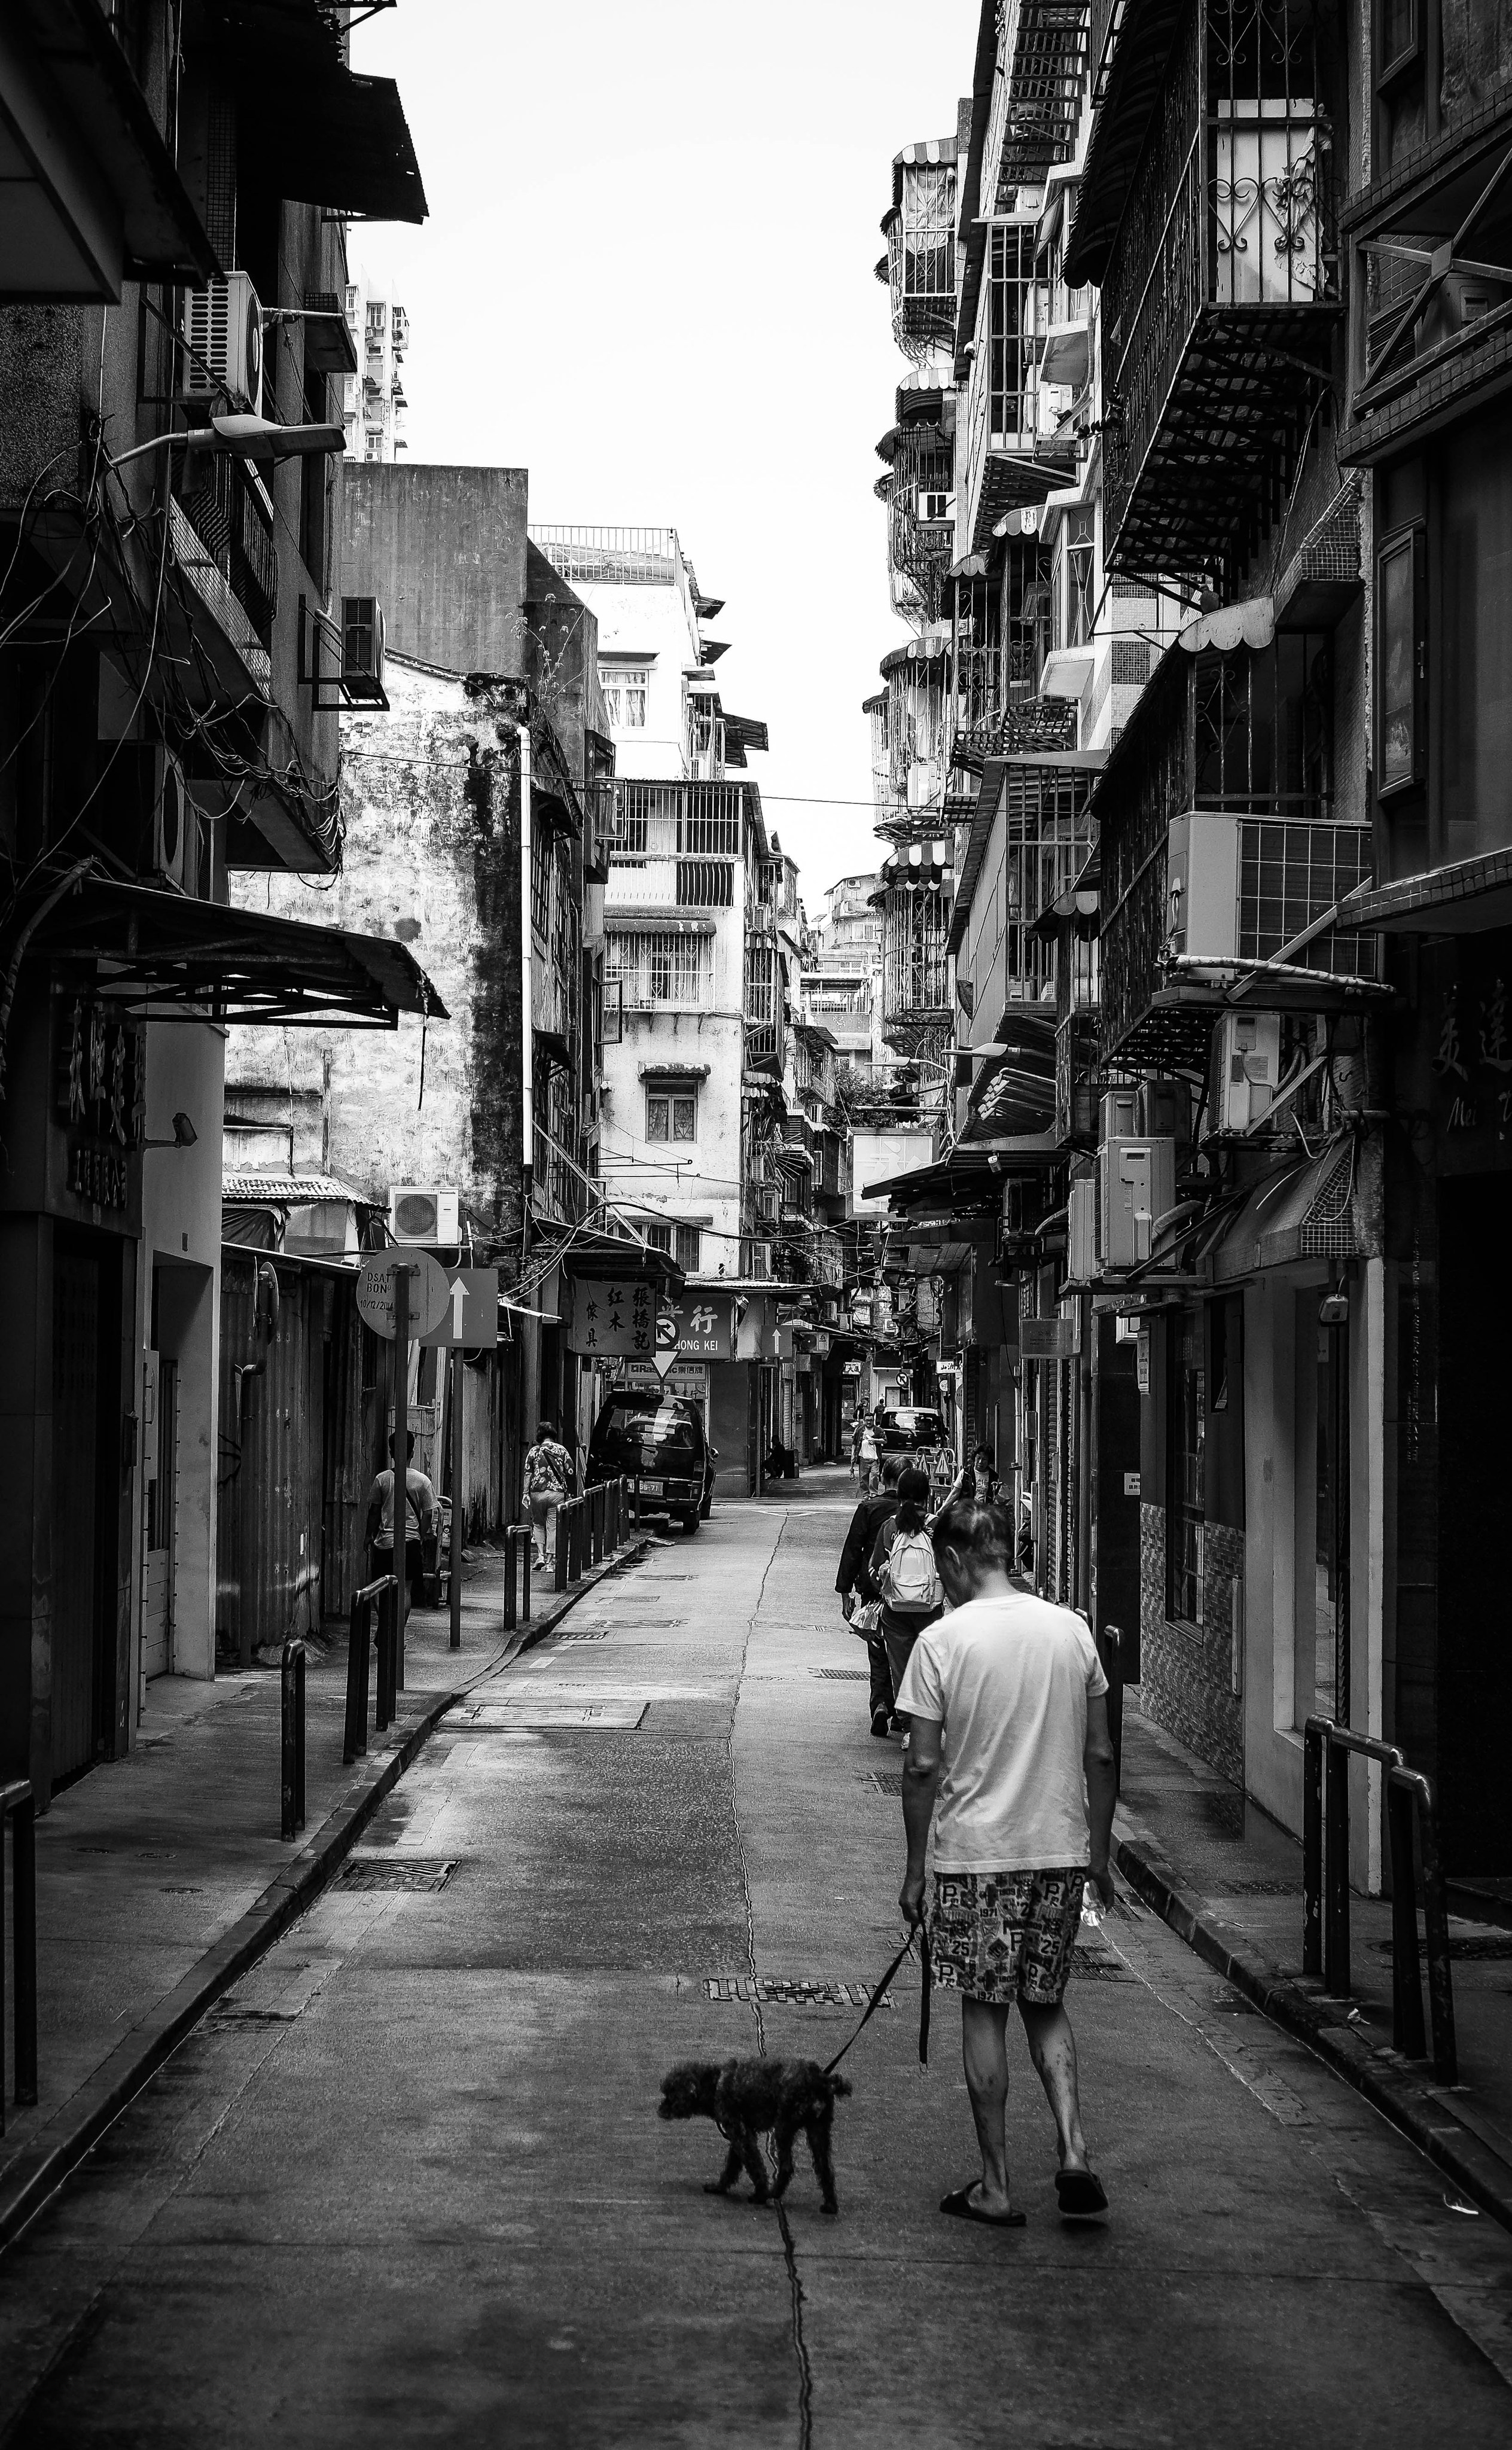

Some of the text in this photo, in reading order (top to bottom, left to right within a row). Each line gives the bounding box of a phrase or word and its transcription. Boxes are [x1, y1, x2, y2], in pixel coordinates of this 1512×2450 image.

[1446, 1095, 1480, 1133] Mei
[607, 1287, 625, 1332] 紅木
[703, 1340, 718, 1351] KEI
[942, 1884, 957, 1904] P
[1044, 1882, 1060, 1900] P
[980, 1908, 998, 1918] 1971
[949, 1939, 970, 1957] '25
[1040, 1937, 1060, 1955] '25
[938, 1964, 954, 1983] P
[976, 1991, 996, 2001] 1971
